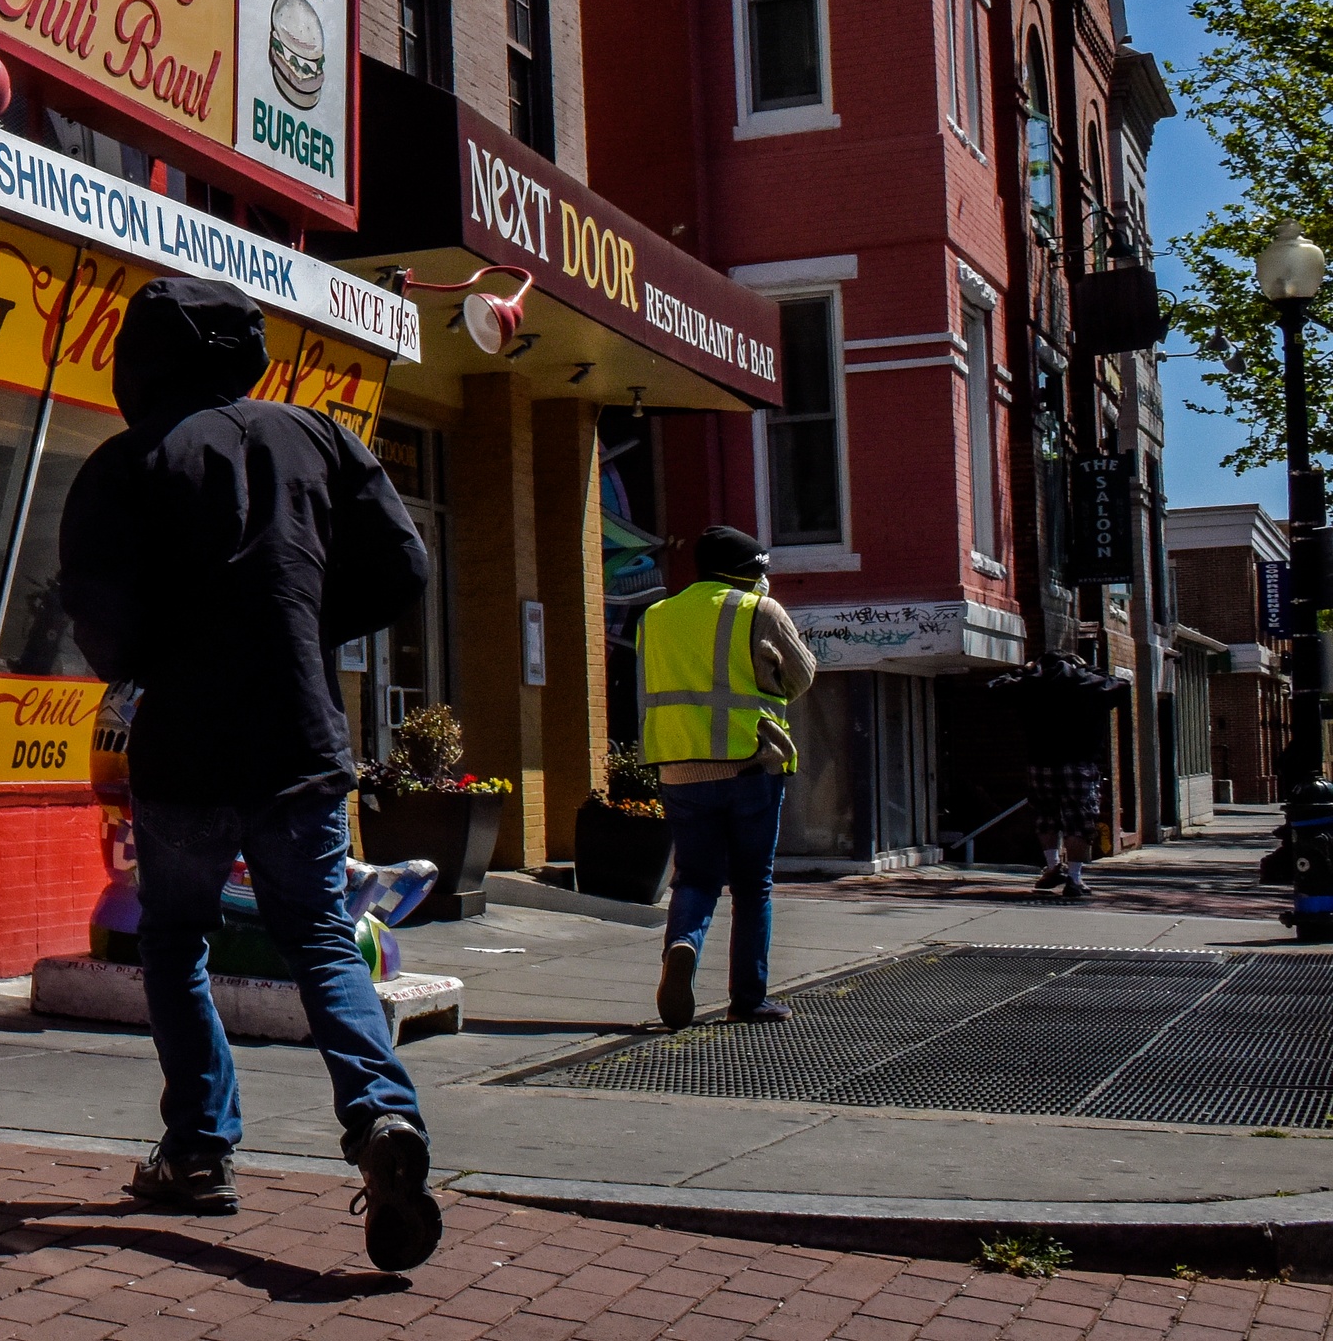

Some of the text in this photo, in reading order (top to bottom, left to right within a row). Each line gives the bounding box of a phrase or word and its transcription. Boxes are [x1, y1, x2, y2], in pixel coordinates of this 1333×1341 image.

[252, 98, 335, 179] BURGER
[157, 206, 298, 301] LANDMARK
[329, 276, 383, 335] SINCE
[388, 303, 418, 350] 1958
[559, 199, 638, 313] DOOR
[644, 282, 734, 363] RESTAURANT
[737, 333, 748, 369] &
[749, 339, 776, 383] BAR
[1079, 459, 1119, 473] THE
[1095, 475, 1112, 558] SALOON
[14, 687, 85, 727] Chili
[11, 740, 69, 769] DOGS
[68, 961, 109, 973] PLEASE
